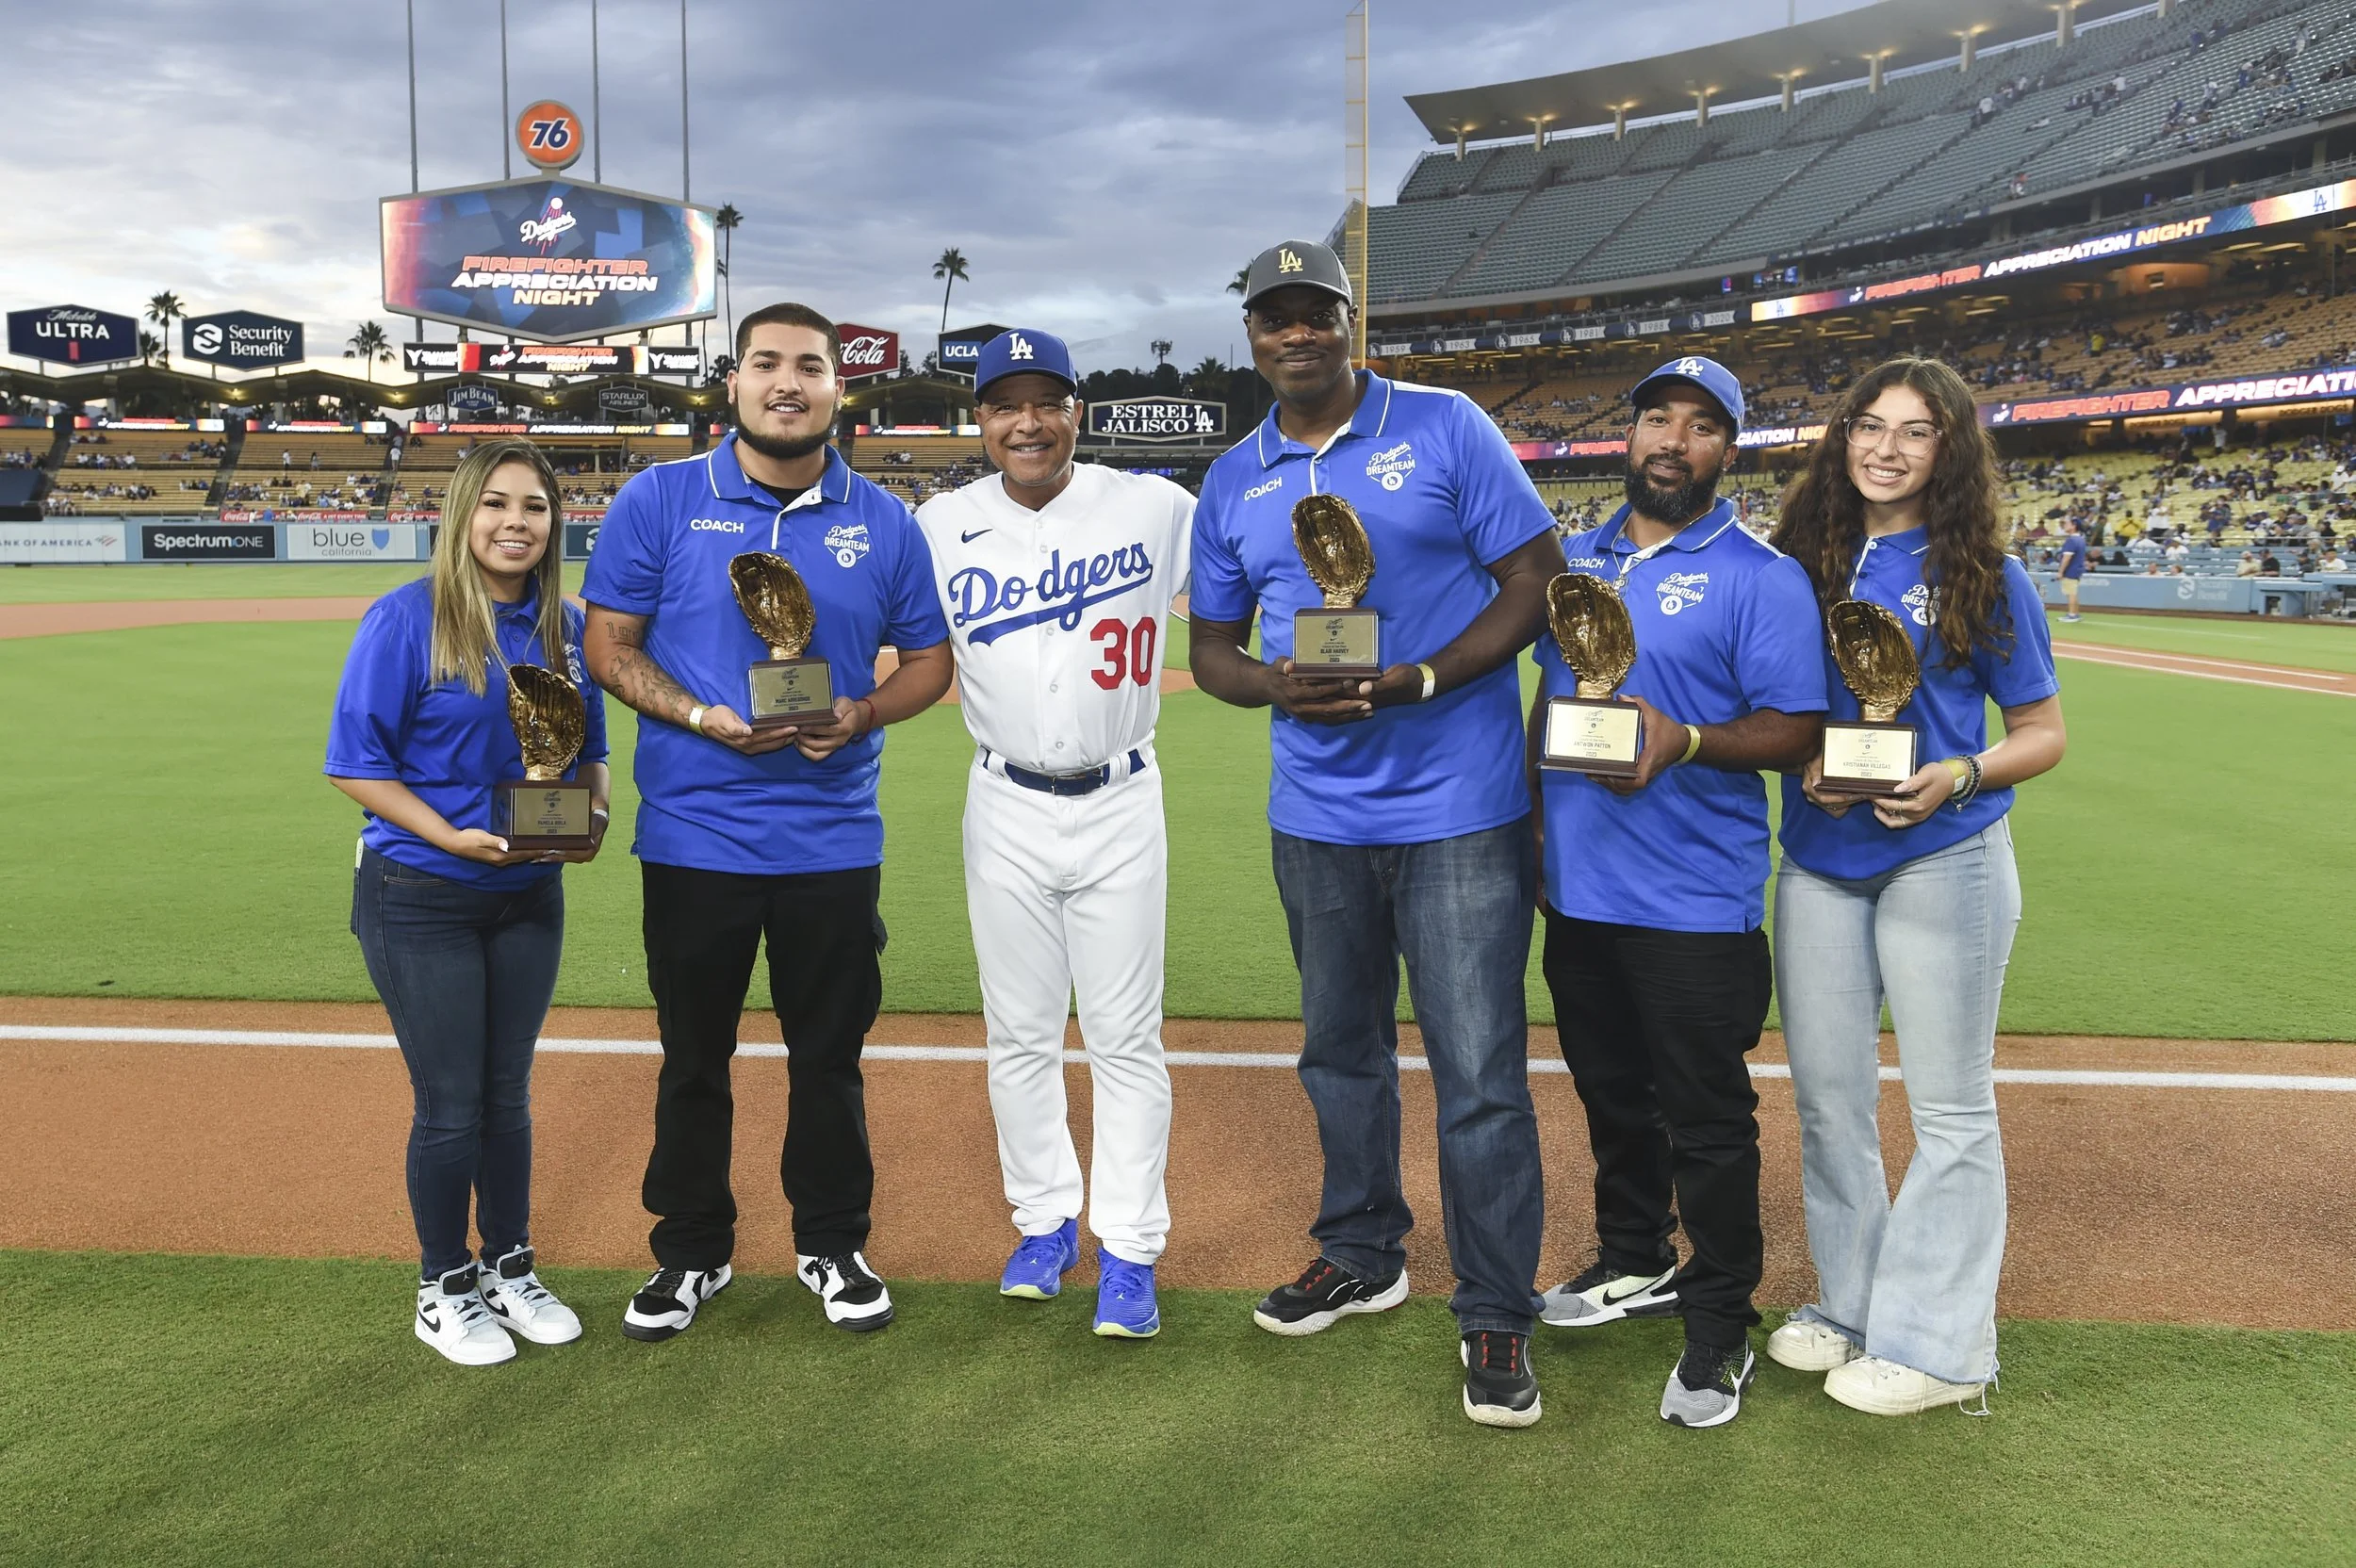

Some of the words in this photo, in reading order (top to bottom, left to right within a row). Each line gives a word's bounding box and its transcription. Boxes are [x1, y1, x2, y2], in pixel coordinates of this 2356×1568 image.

[528, 118, 570, 149] 76
[520, 211, 577, 243] Dodgers
[1984, 232, 2132, 279] APPRECIATION
[2135, 216, 2212, 247] NIGHT
[462, 255, 648, 275] FIREFIGHTER
[1279, 248, 1303, 274] LA
[451, 271, 659, 292] APPRECIATION
[513, 289, 601, 306] NIGHT
[36, 321, 110, 340] ULTRA
[228, 324, 293, 344] Security
[1579, 329, 1599, 338] 1981
[1644, 321, 1664, 331] 1988
[230, 340, 286, 357] Benefit
[1009, 332, 1034, 361] LA
[1385, 345, 1406, 353] 1959
[1514, 335, 1535, 345] 1965
[944, 345, 980, 358] UCLA
[547, 363, 591, 372] NIGHT
[1676, 357, 1704, 377] LA
[450, 390, 467, 406] JIM
[469, 387, 495, 405] BEAM
[601, 392, 646, 400] STARLUX
[2012, 390, 2170, 422] FIREFIGHTER
[2174, 369, 2356, 408] APPRECIATI
[1102, 418, 1189, 433] JALISCO
[1371, 441, 1412, 466] Dodgers
[1366, 458, 1415, 477] DREAMTEAM
[1244, 477, 1283, 501] COACH
[690, 518, 745, 534] COACH
[830, 524, 869, 539] Dodgers
[154, 533, 232, 550] Spectrum
[313, 528, 365, 547] blue
[824, 536, 870, 553] DREAMTEAM
[321, 548, 372, 557] california
[1568, 558, 1607, 569] COACH
[1668, 572, 1710, 586] Dodgers
[948, 542, 1153, 646] Dodgers
[1656, 582, 1705, 603] DREAMTEAM
[1089, 616, 1157, 691] 30
